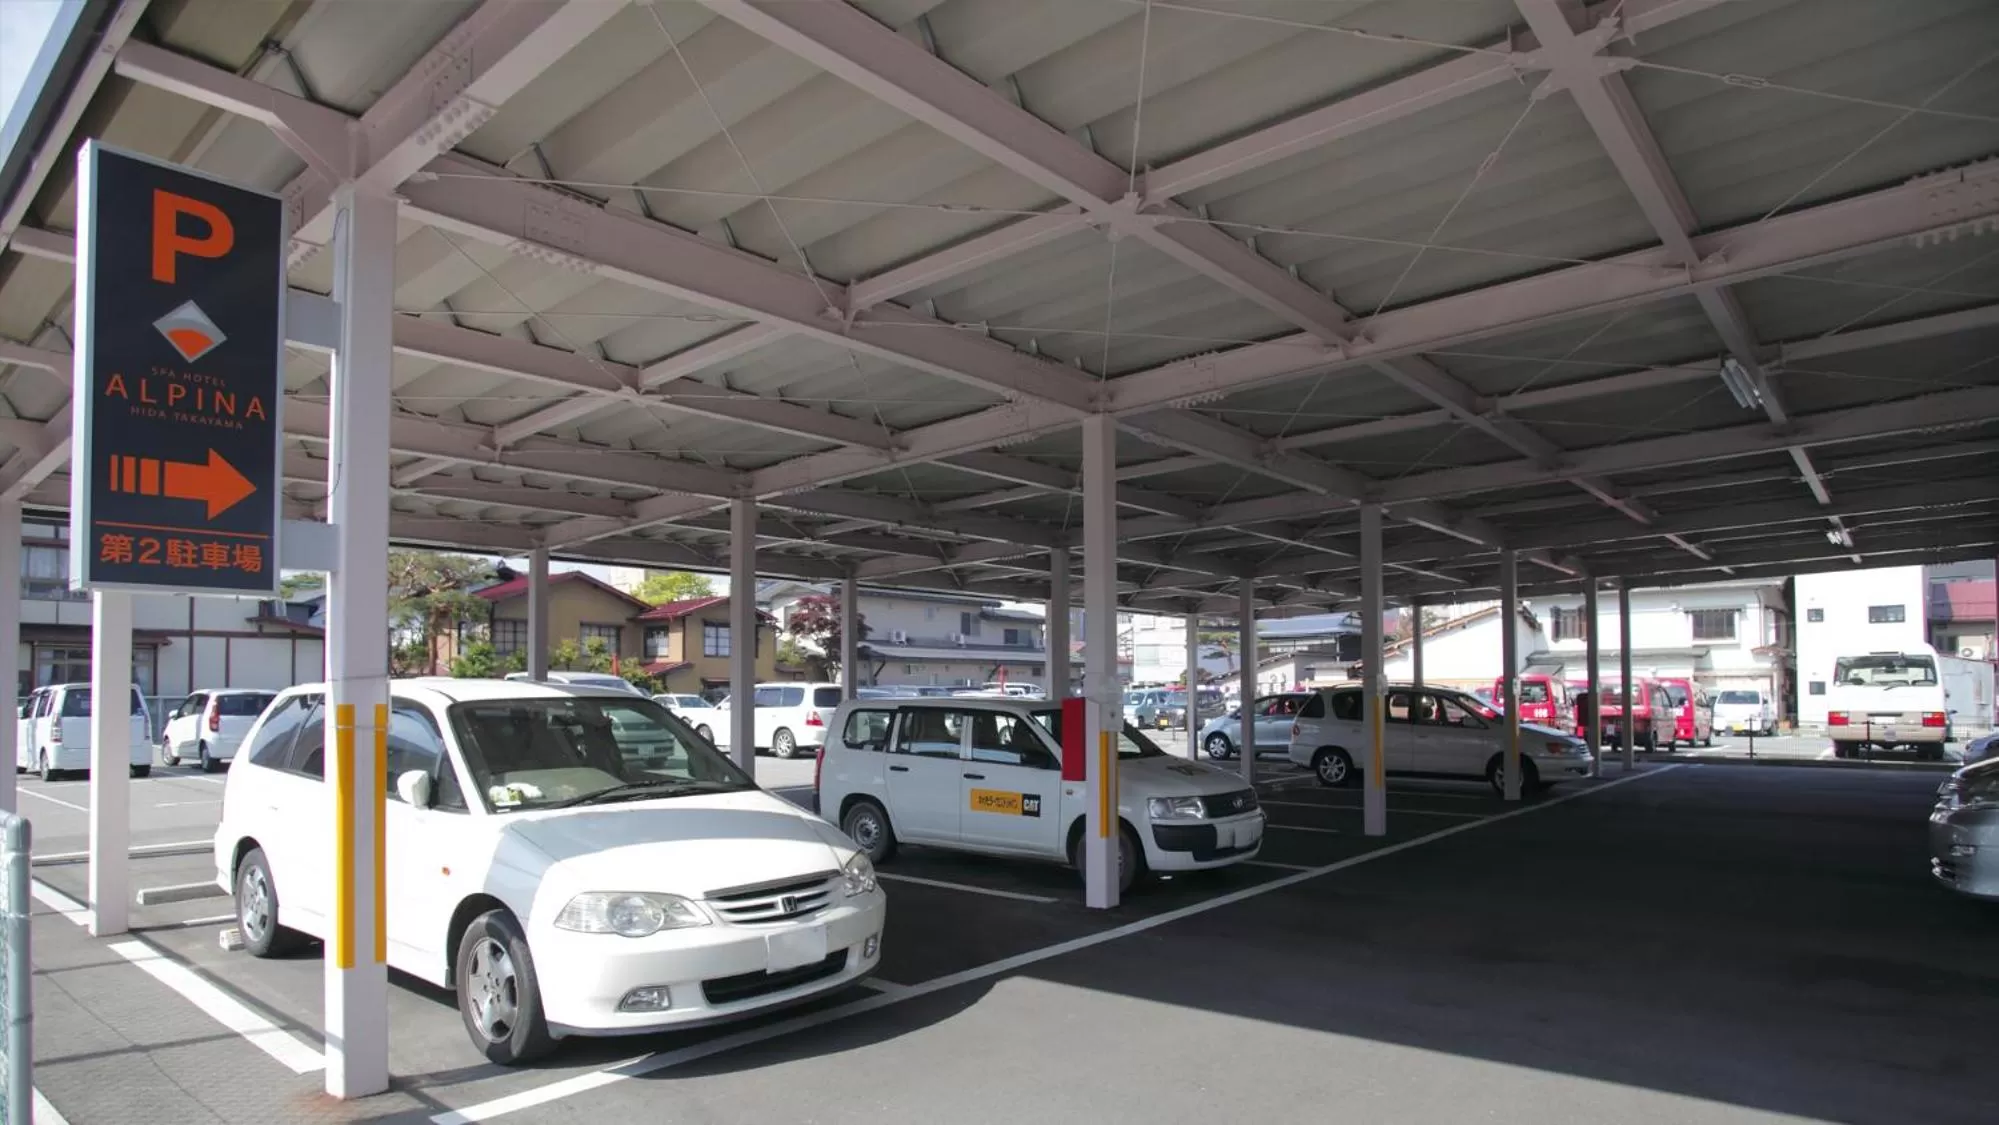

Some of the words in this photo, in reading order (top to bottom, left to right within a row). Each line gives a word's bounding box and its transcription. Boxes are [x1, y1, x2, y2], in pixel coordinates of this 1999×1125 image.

[152, 188, 235, 284] P
[151, 366, 176, 379] SPA
[183, 373, 226, 387] HOTEL
[104, 373, 266, 421] ALPINA
[130, 406, 167, 420] HIDA
[174, 411, 243, 430] TAKAYAMA
[101, 533, 263, 573] 第2駐車場
[1023, 798, 1039, 812] CAT
